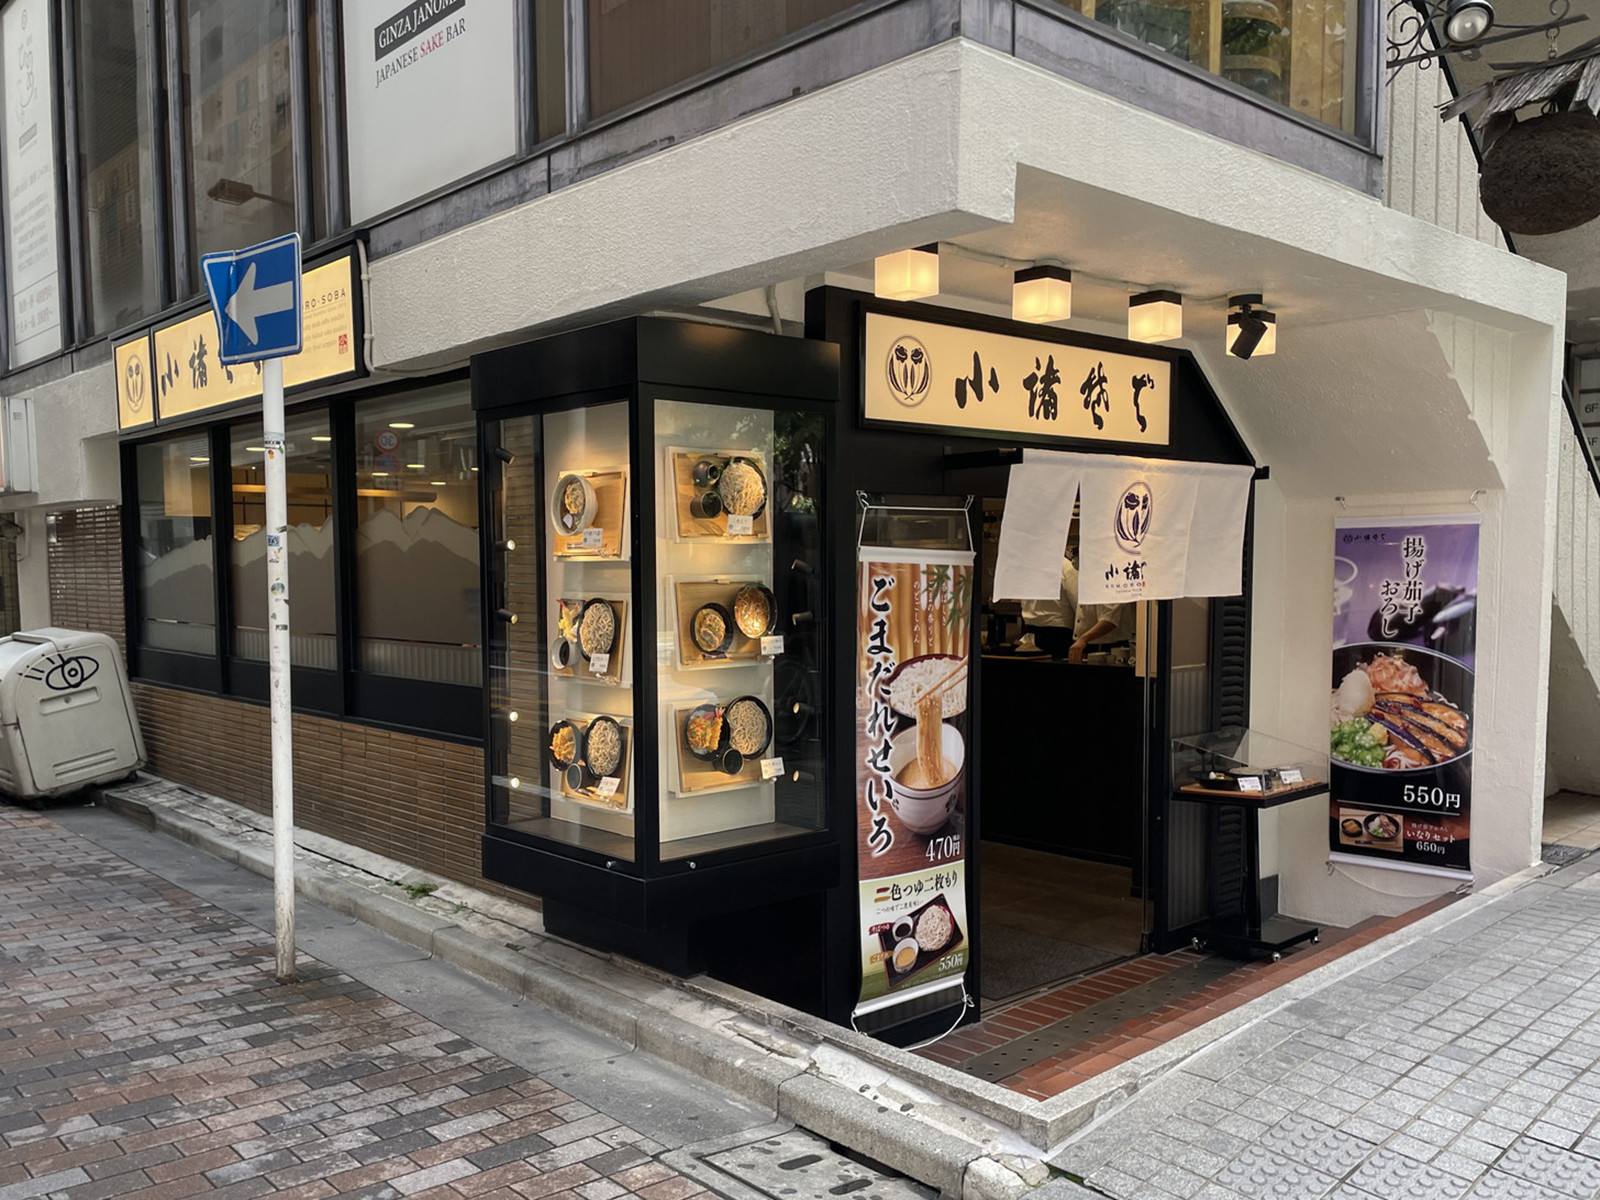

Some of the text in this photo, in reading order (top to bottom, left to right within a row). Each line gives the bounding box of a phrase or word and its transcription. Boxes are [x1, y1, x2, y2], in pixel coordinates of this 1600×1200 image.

[379, 15, 412, 48] GINZA
[376, 18, 466, 88] JAPANESE SAKE BAR
[1585, 403, 1599, 414] 6F
[1402, 537, 1425, 623] 揚げ茄子
[1380, 580, 1400, 637] おろし
[867, 577, 897, 855] ごまだれせいろ
[1403, 784, 1461, 808] 550円
[1406, 830, 1456, 843] いなりセット
[1416, 840, 1446, 854] 650円
[874, 870, 958, 903] 二色つゆ二枚もり
